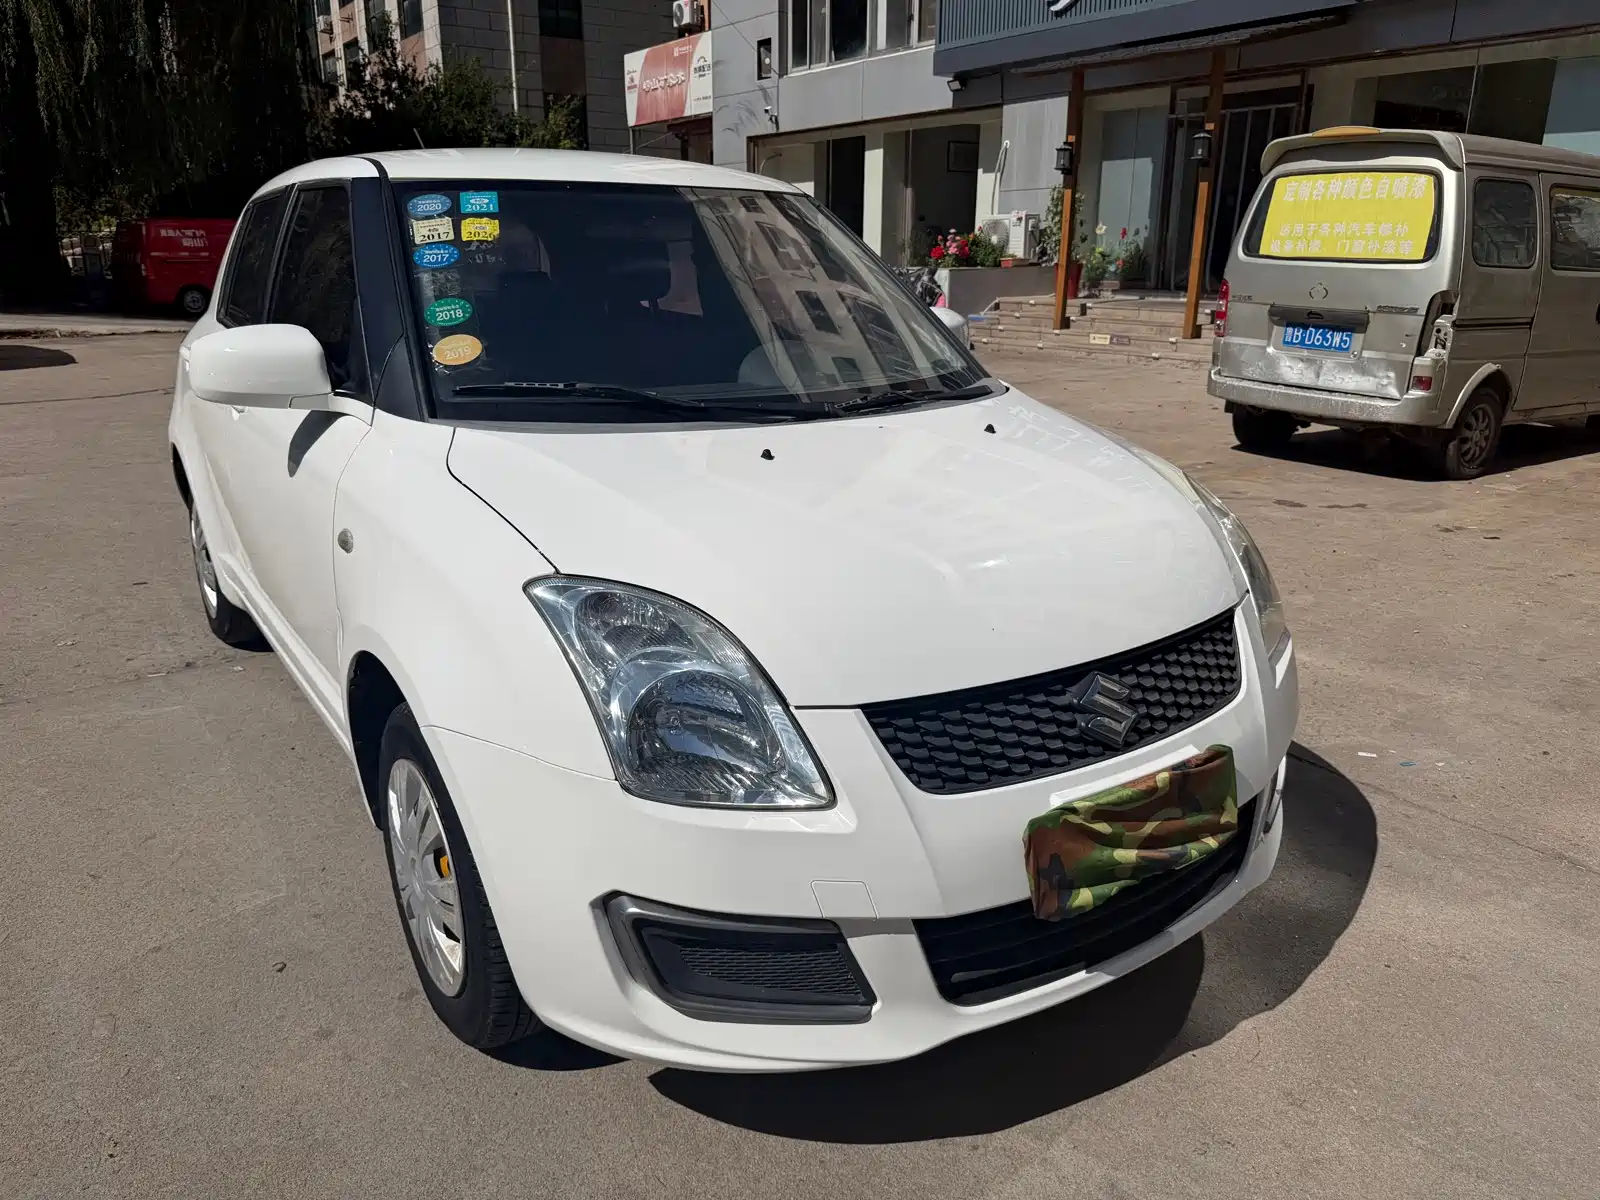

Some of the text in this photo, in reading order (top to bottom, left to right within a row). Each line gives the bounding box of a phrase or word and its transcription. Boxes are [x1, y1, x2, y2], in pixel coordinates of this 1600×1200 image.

[416, 203, 442, 212] 2020
[465, 204, 494, 212] 2021
[419, 231, 451, 243] 2017
[422, 254, 450, 263] 2017
[435, 308, 464, 322] 2018
[444, 345, 472, 360] 2019
